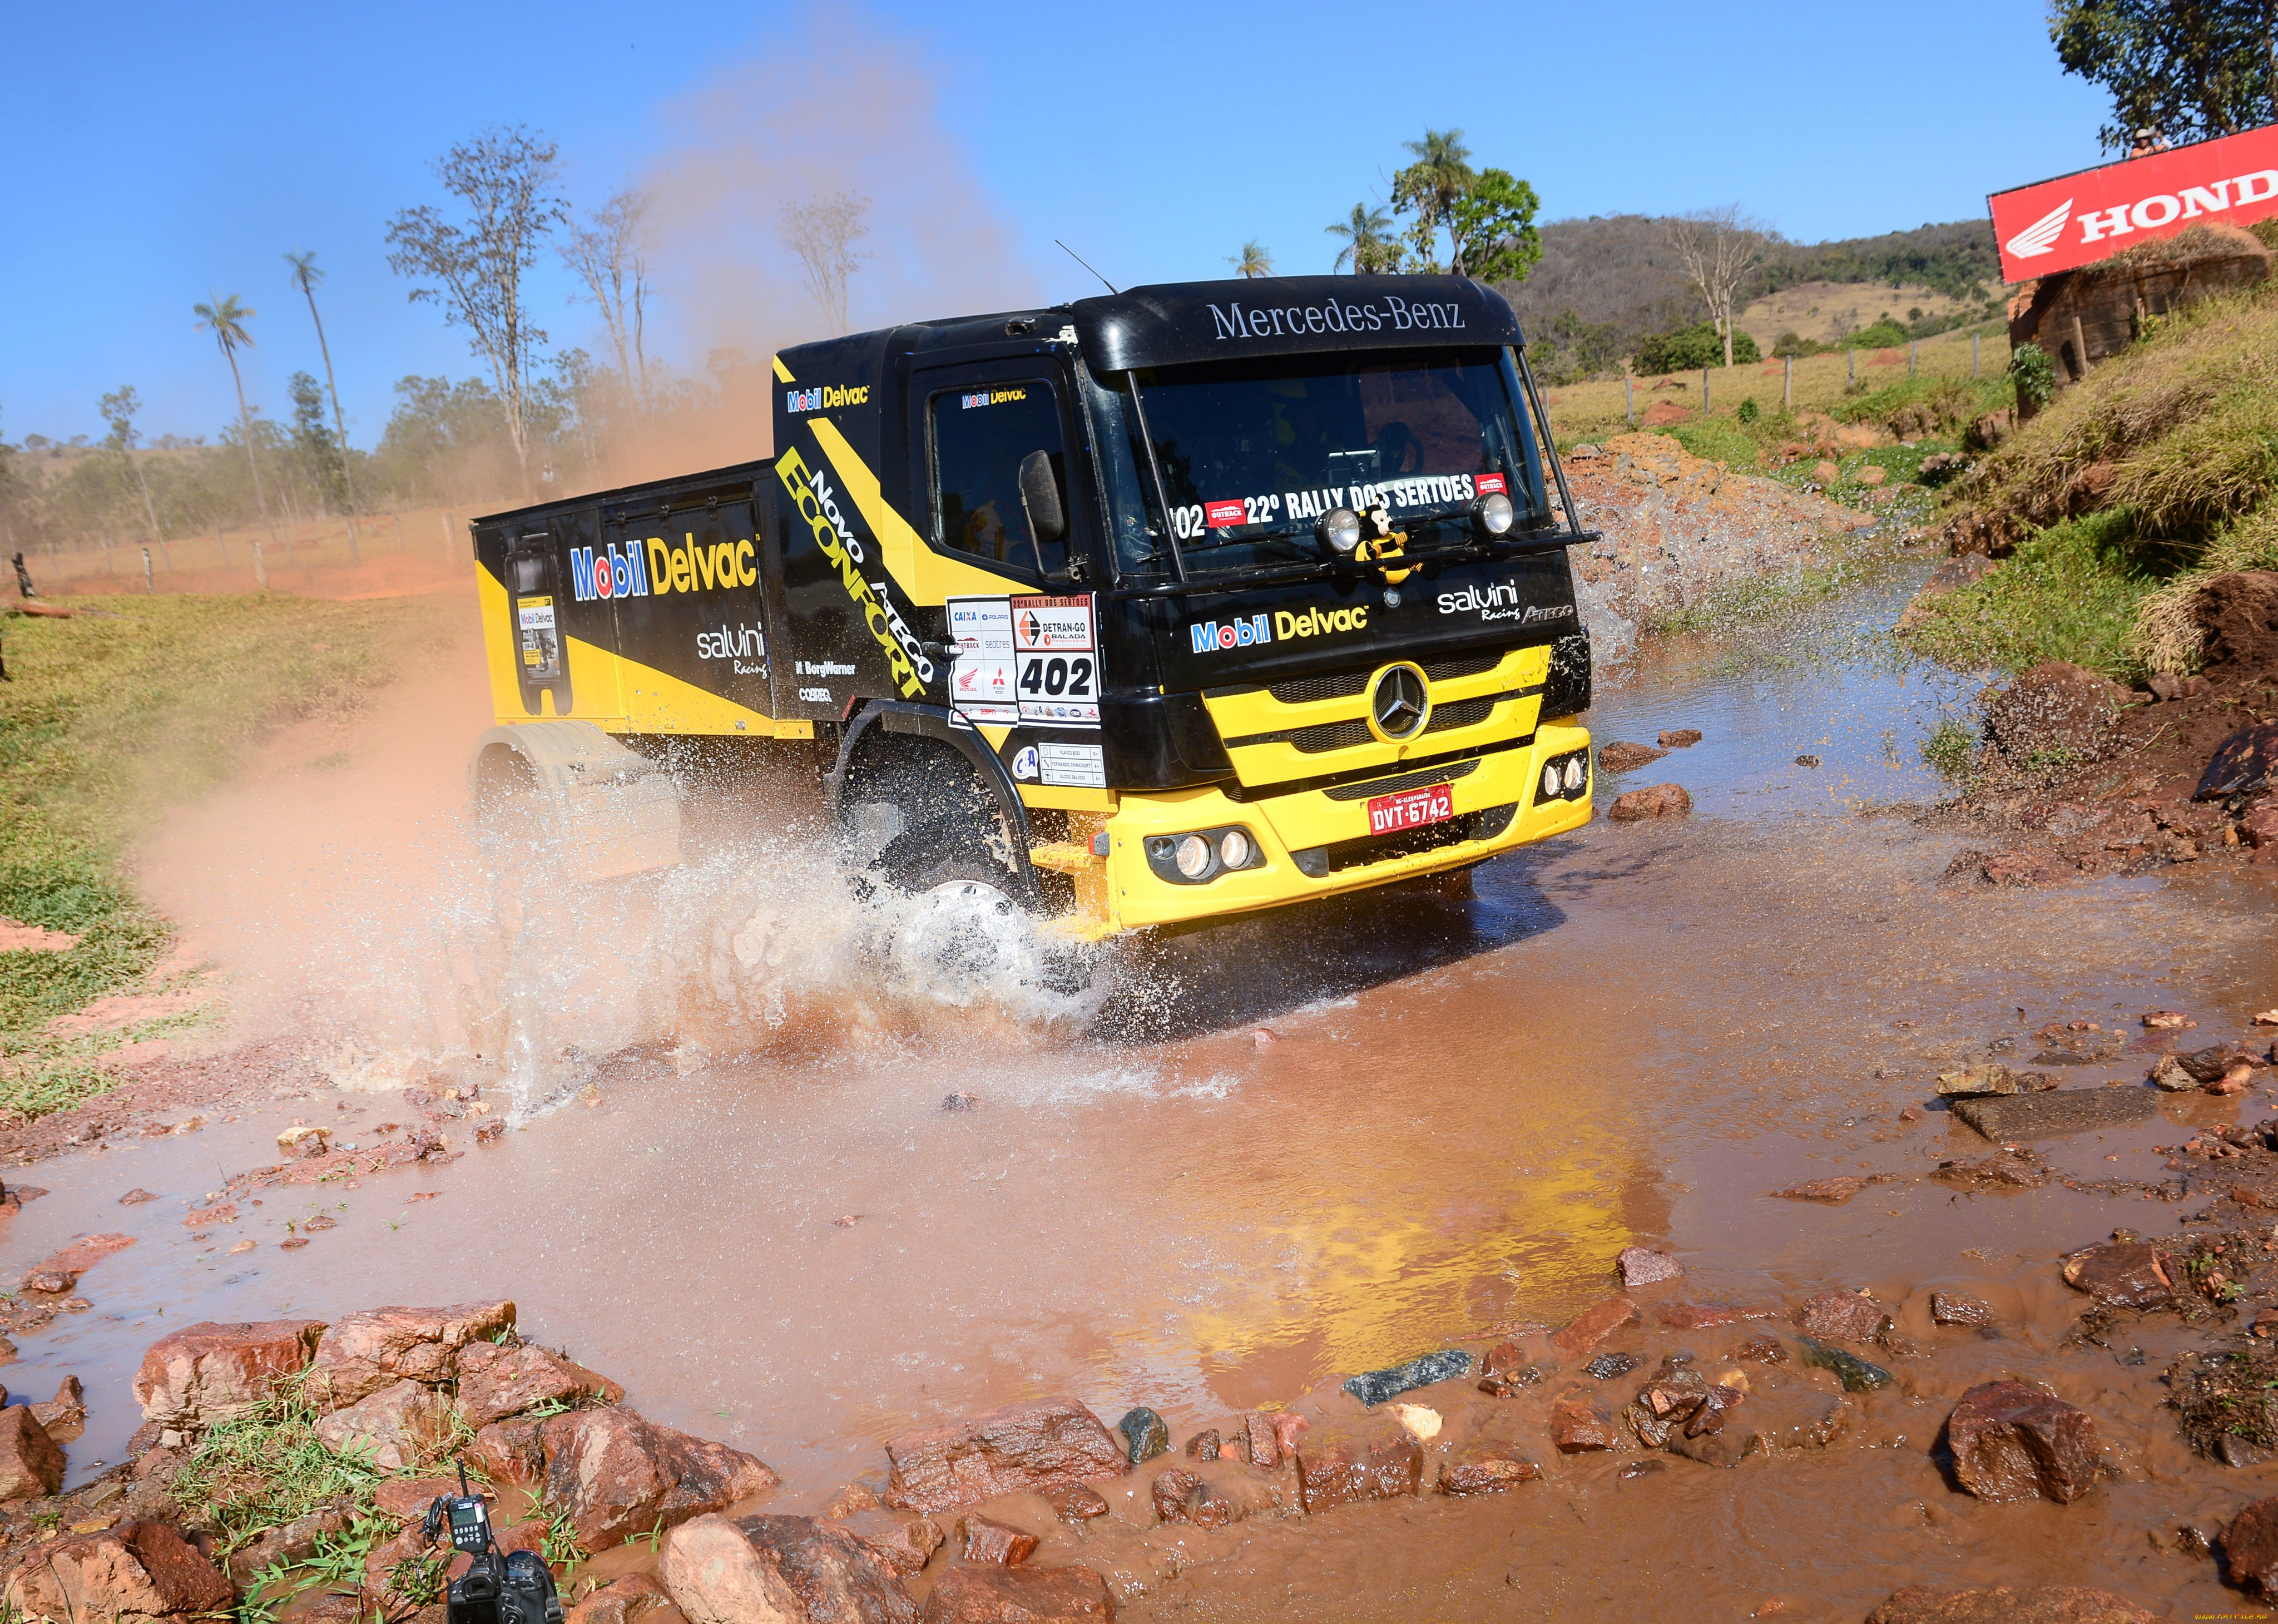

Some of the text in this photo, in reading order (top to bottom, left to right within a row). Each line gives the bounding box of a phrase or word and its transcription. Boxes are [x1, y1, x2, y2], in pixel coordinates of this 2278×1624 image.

[2077, 169, 2278, 245] HOND
[1206, 295, 1465, 339] Mercedes-Benz
[788, 384, 869, 413] Mobil Delvac
[962, 388, 1026, 409] Mobil Delvac
[1168, 504, 1205, 539] 02
[1285, 487, 1344, 519] RALLY
[1349, 483, 1390, 512] DOS
[1393, 473, 1474, 508] SERTOES
[1211, 510, 1242, 518] OUTBACK
[570, 532, 757, 601] Mobil Delvac
[774, 445, 926, 699] ECONFORT
[809, 469, 934, 682] NOVO ATEGO
[1437, 578, 1518, 614] salvini
[1482, 607, 1521, 621] Racing
[521, 612, 553, 625] Mobil Delvac
[954, 611, 977, 621] CAIXA
[1190, 606, 1368, 653] Mobil Delvac
[696, 621, 765, 659] salvini
[734, 660, 767, 679] Racing
[805, 661, 856, 677] BorgWarner
[1019, 657, 1093, 696] 402
[799, 687, 833, 702] COBREQ
